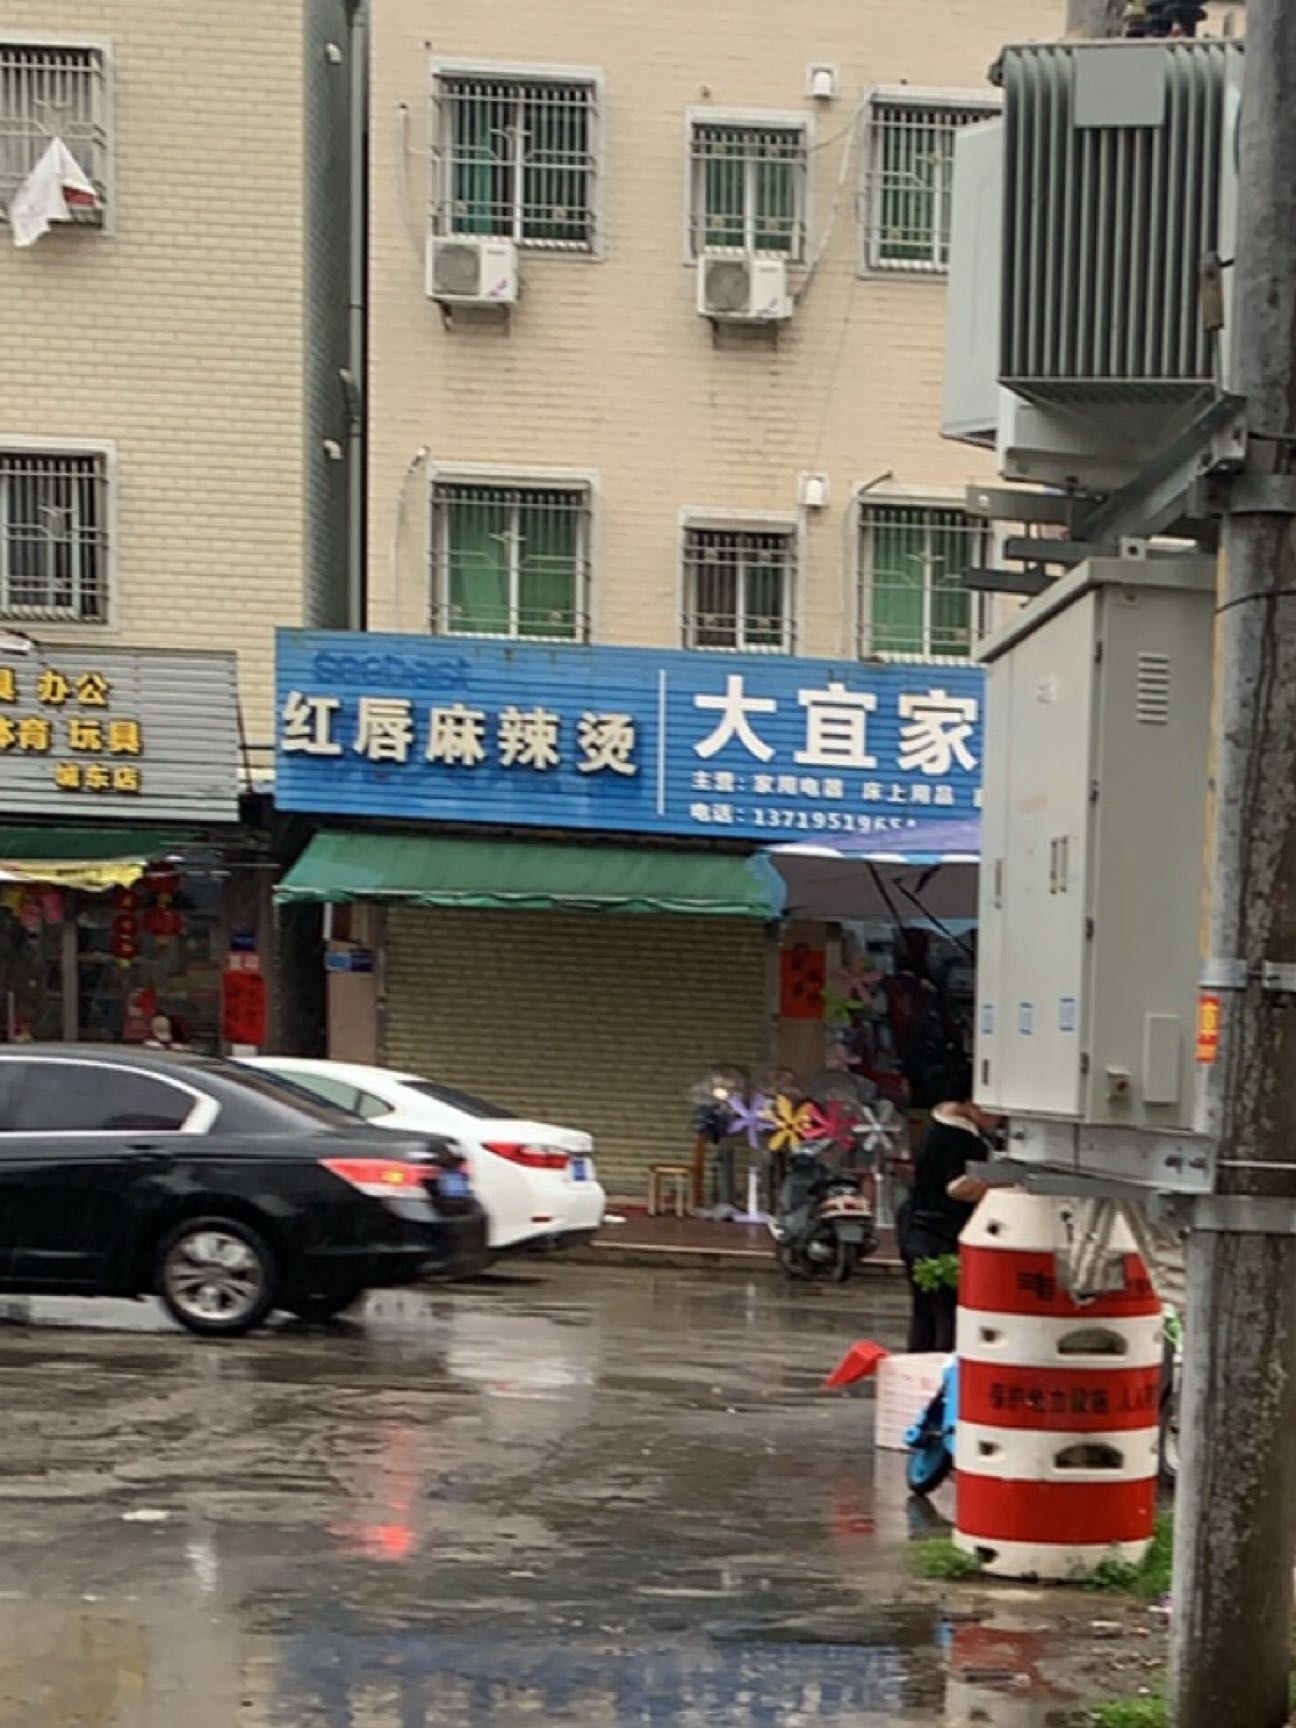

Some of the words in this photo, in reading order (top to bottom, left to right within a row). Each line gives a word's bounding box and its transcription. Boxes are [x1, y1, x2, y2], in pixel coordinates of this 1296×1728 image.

[38, 669, 110, 706] 办公
[69, 716, 143, 756] 玩具
[280, 690, 637, 776] 红唇麻辣烫
[693, 674, 979, 776] 大宜家
